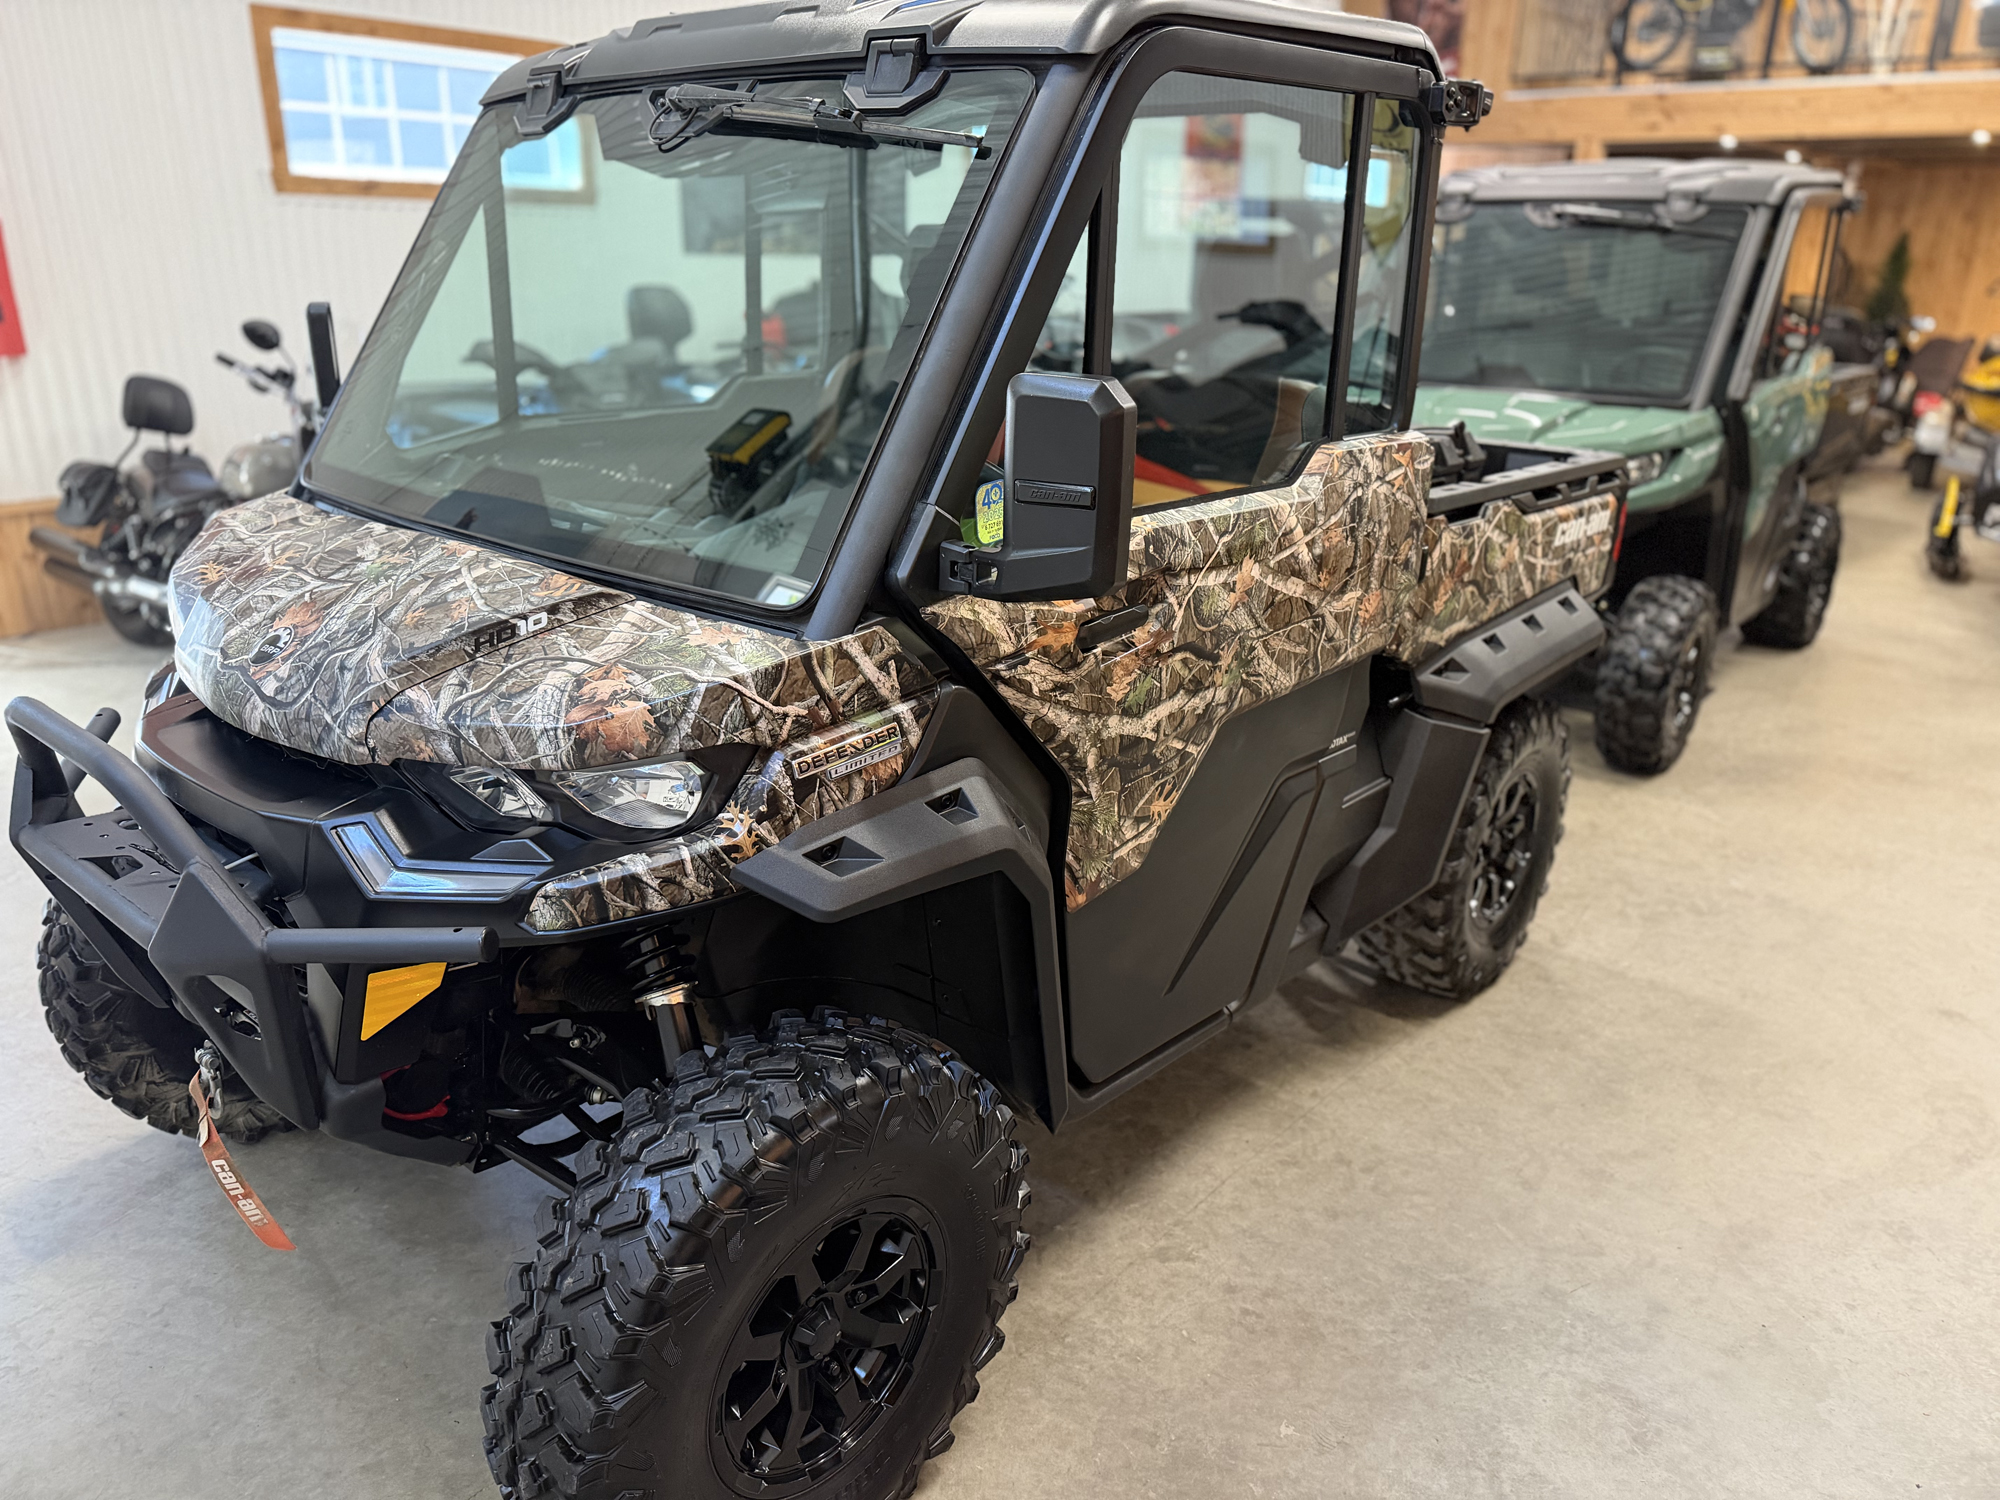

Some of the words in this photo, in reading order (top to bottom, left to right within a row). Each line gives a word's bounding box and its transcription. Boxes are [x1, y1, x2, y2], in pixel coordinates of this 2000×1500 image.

[1030, 488, 1082, 502] can-am
[1553, 509, 1611, 547] can-am
[260, 643, 281, 655] BRP
[474, 611, 548, 653] HD10
[797, 725, 899, 775] DEFENDER
[834, 745, 898, 775] LIMITED
